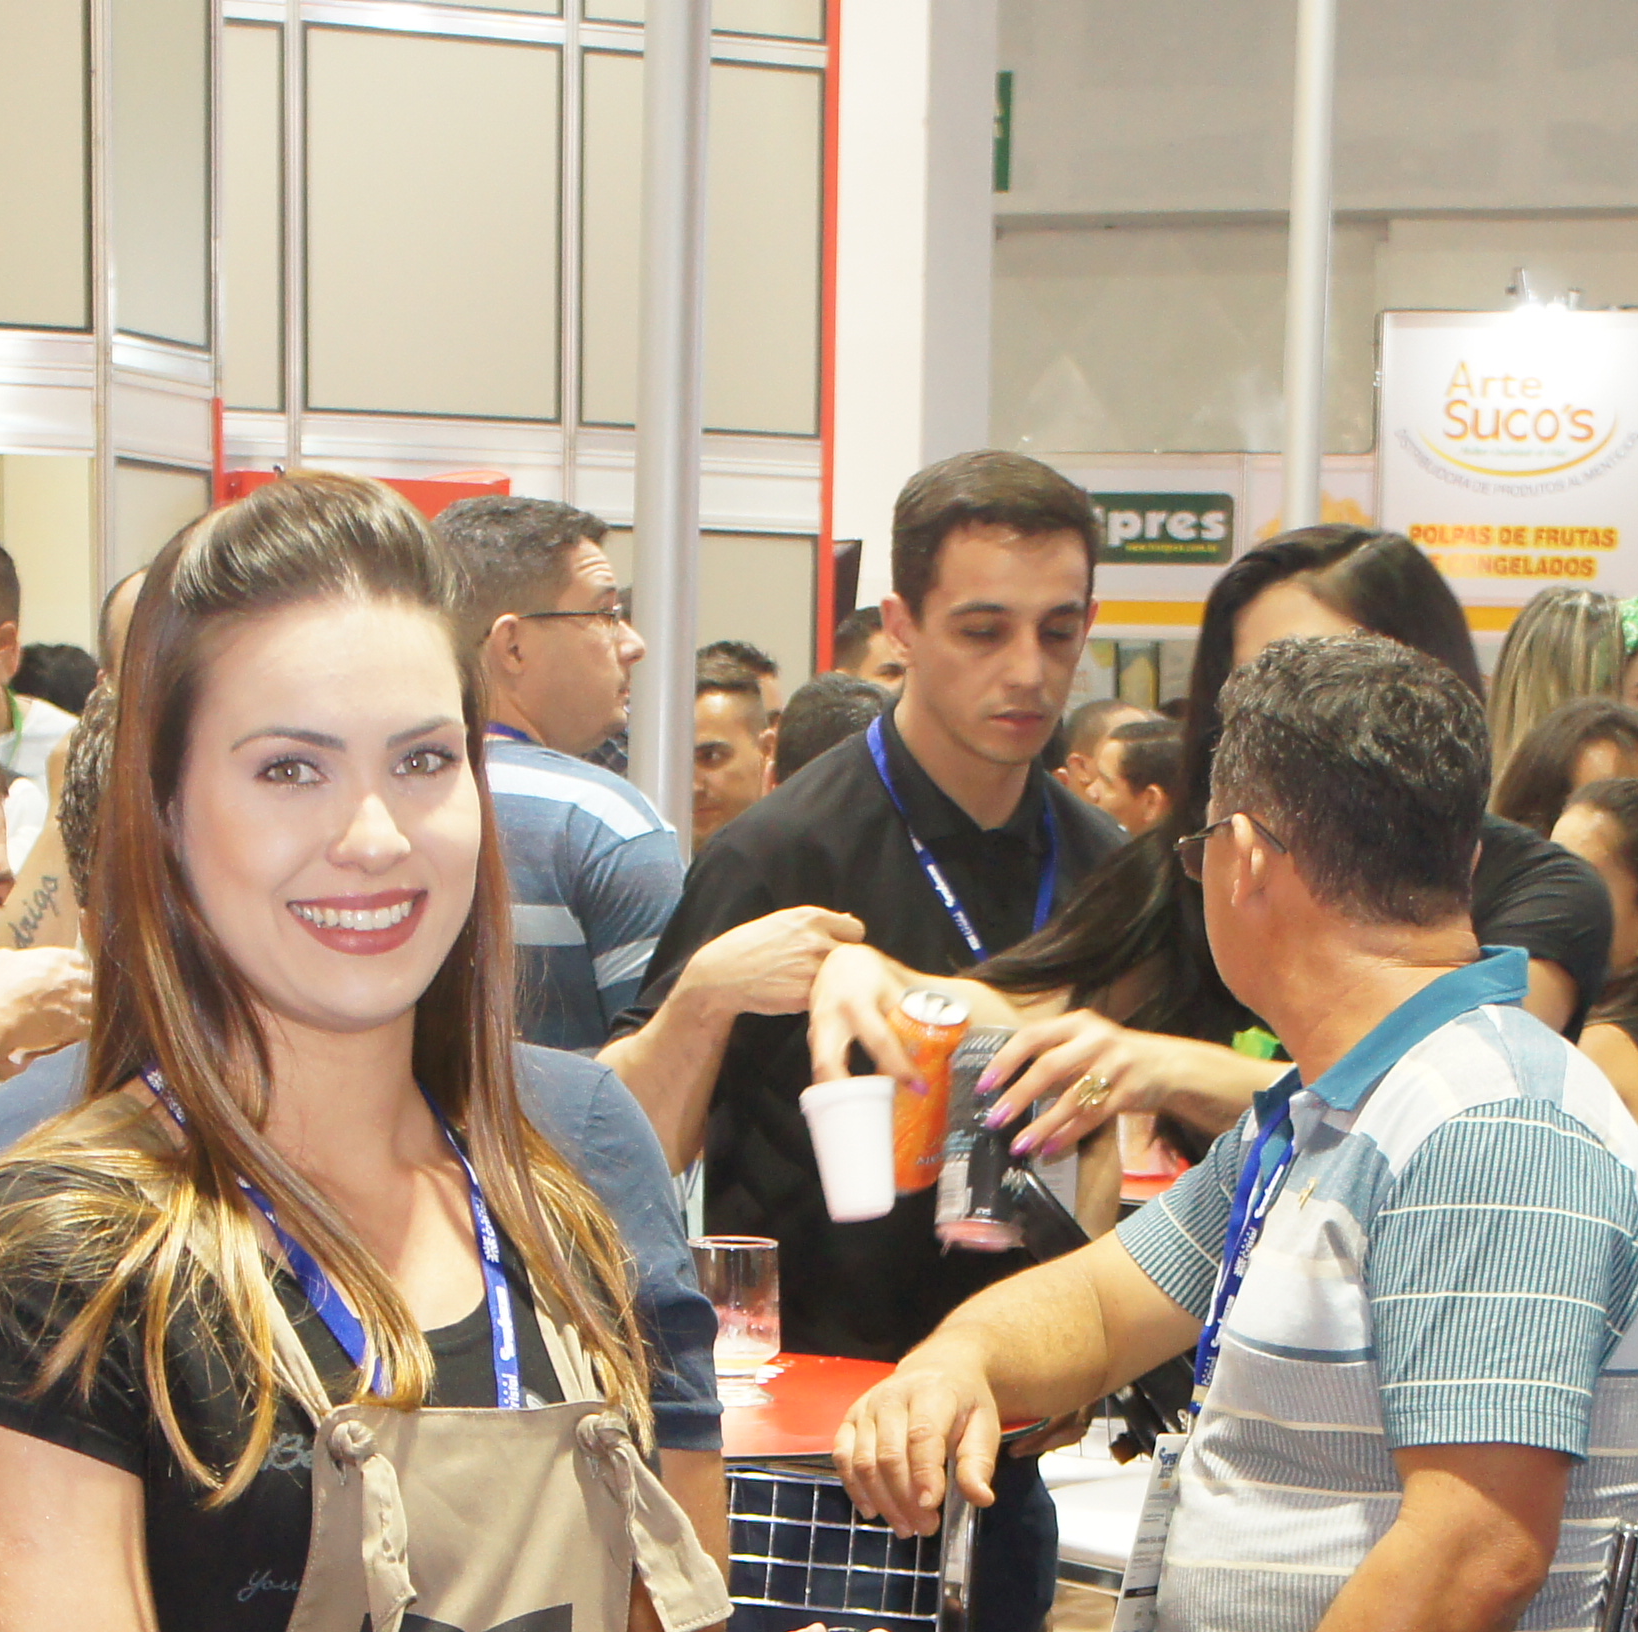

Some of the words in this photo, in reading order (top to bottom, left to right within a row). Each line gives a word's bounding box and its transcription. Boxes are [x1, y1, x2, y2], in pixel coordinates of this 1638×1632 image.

[1445, 361, 1544, 398] Arte
[1443, 399, 1595, 443] Suco's
[1410, 525, 1493, 546] POLPAS
[1499, 526, 1527, 546] DE
[1533, 526, 1617, 548] FRUTAS
